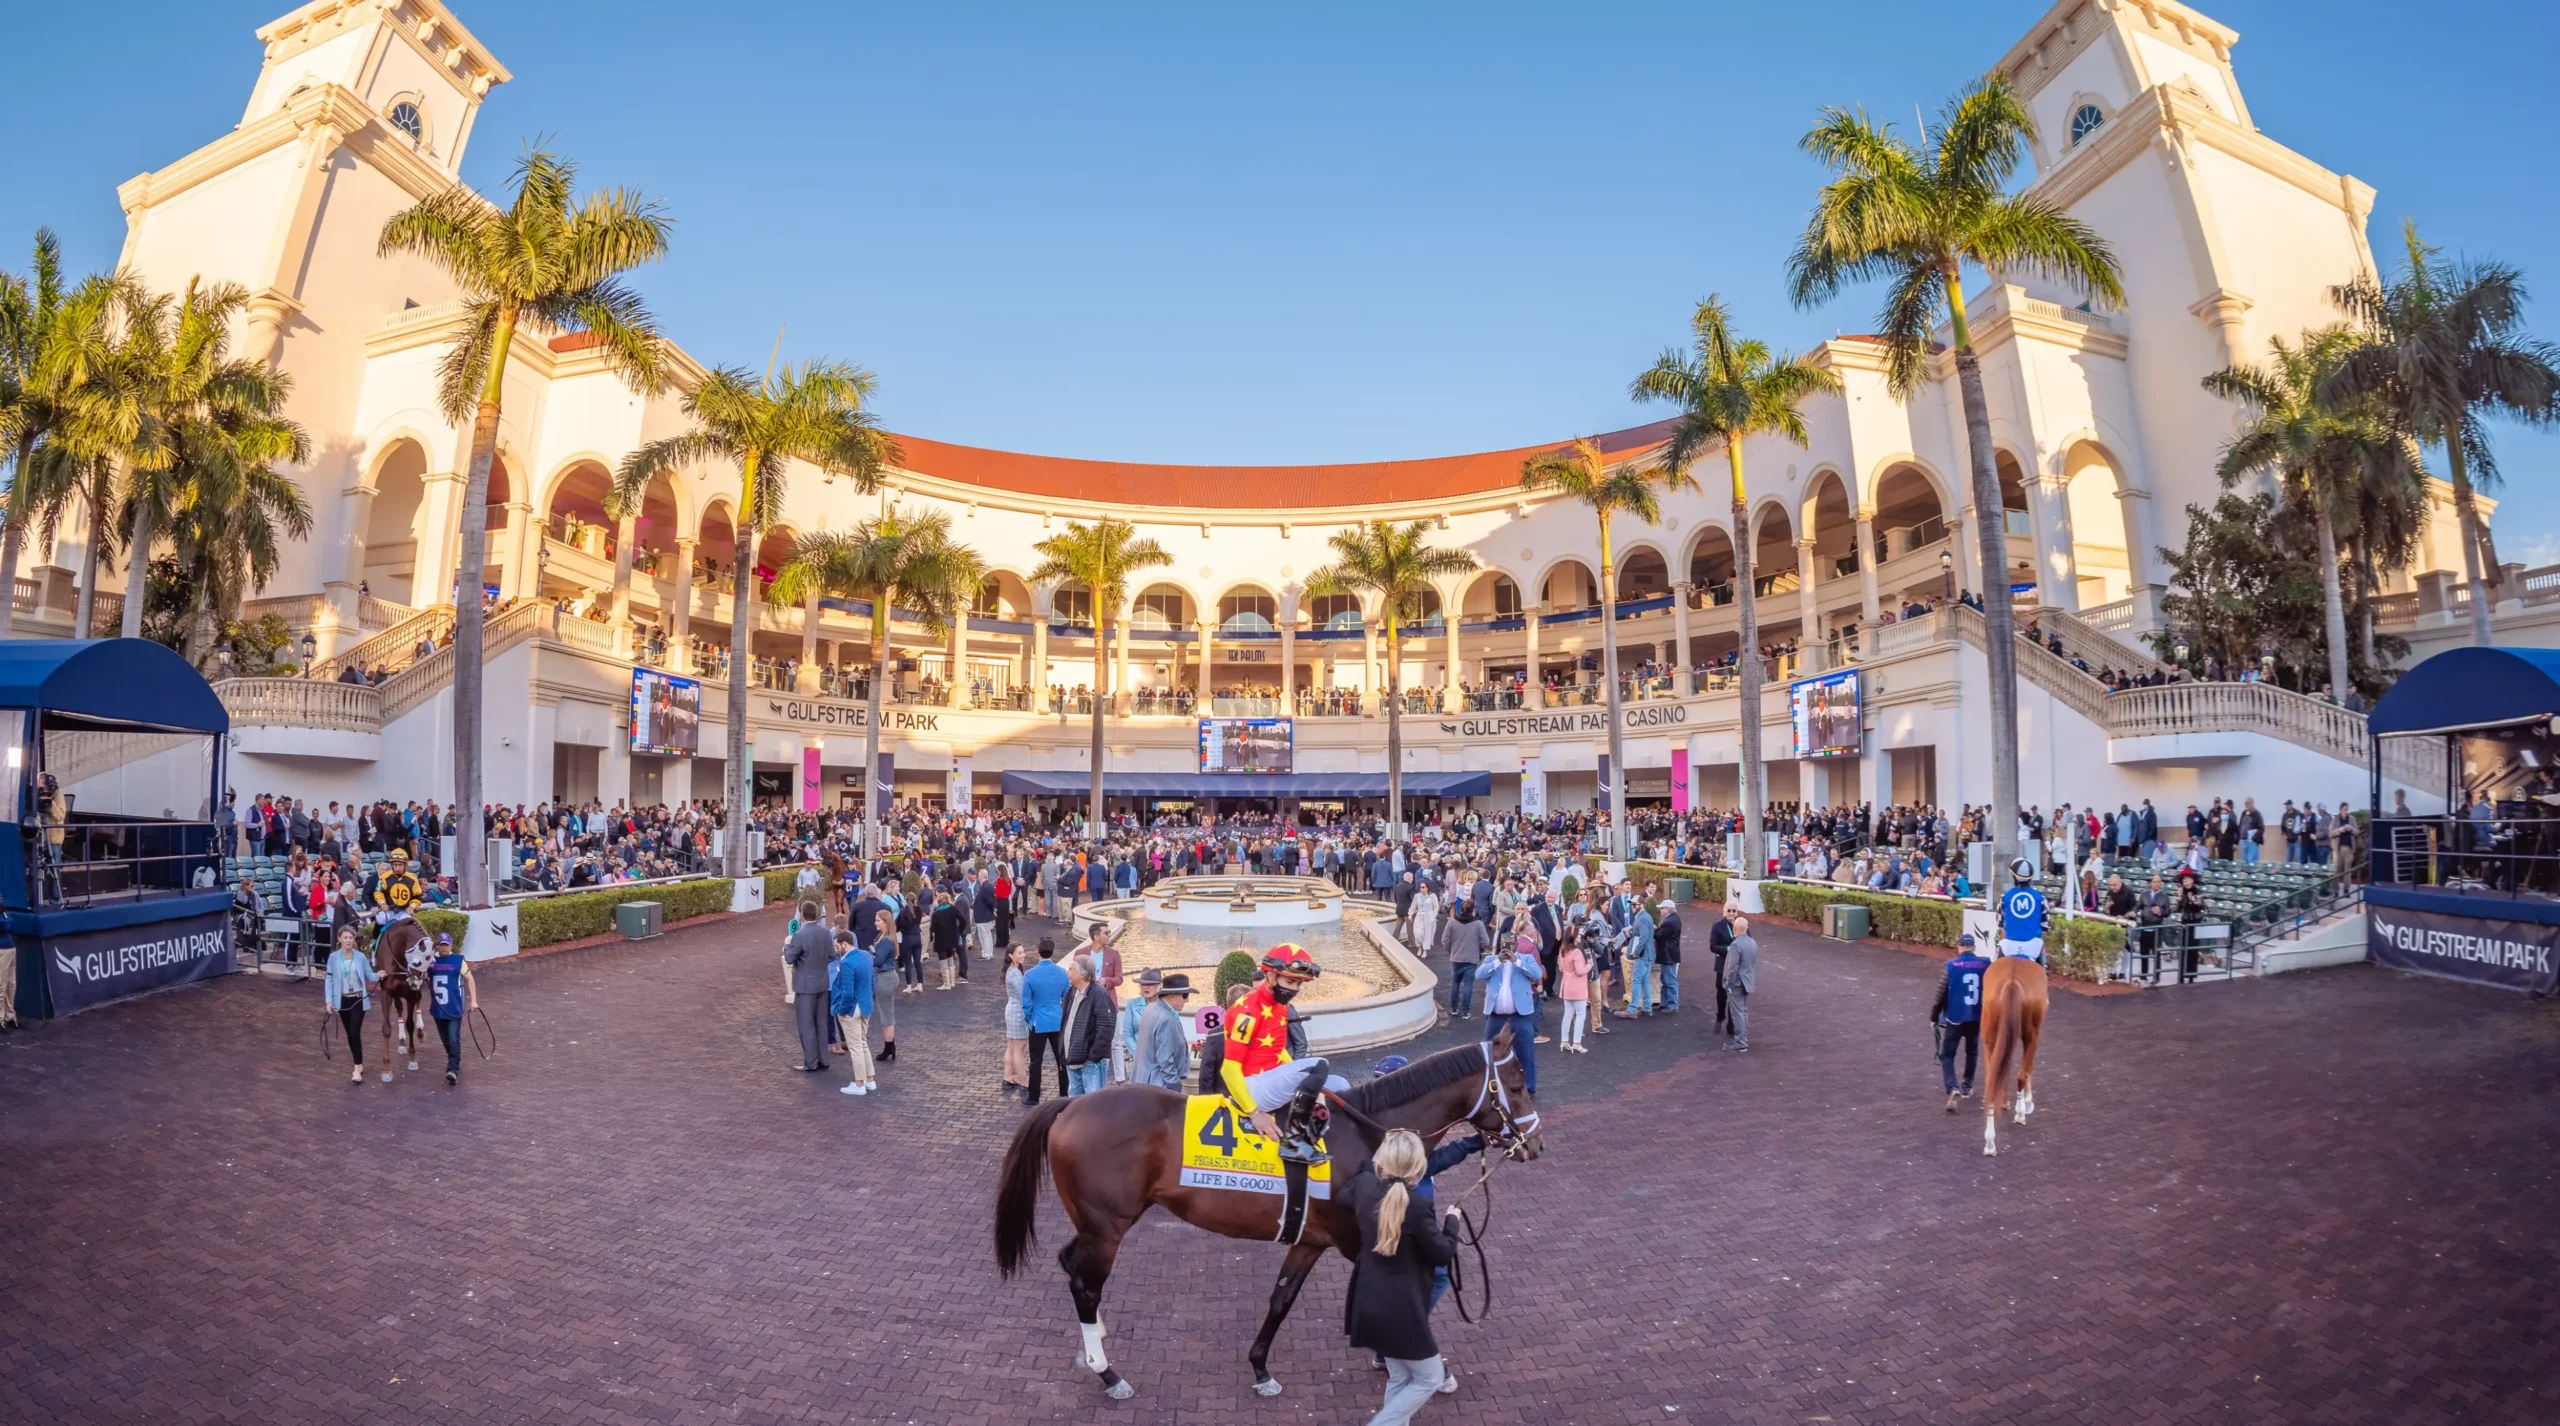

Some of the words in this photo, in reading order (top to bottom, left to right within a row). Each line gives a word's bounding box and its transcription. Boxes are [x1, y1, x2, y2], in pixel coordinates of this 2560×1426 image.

[1240, 649, 1265, 662] PALMS
[787, 701, 889, 728] GULFSTREM
[896, 712, 938, 731] PARK
[1462, 715, 1574, 736] GULFSTREAM
[1581, 713, 1608, 730] PAR
[1626, 705, 1686, 727] CASINO
[921, 865, 928, 875] 7
[394, 889, 408, 900] JG
[2016, 898, 2029, 912] M
[86, 936, 188, 981] GULFSTREAM
[190, 929, 226, 960] PARK
[2396, 926, 2501, 966] GULFSTREAM
[432, 975, 449, 1005] 5
[1962, 973, 1980, 1006] 3
[1204, 1012, 1220, 1029] 8
[1237, 1017, 1251, 1041] 4
[1198, 1106, 1238, 1157] 4
[1193, 1155, 1229, 1168] PEGASUS
[1231, 1159, 1258, 1172] WORLD
[1260, 1162, 1275, 1174] CUP
[1193, 1172, 1222, 1186] LIFE
[1225, 1175, 1237, 1187] IS
[1240, 1177, 1275, 1191] GOOD
